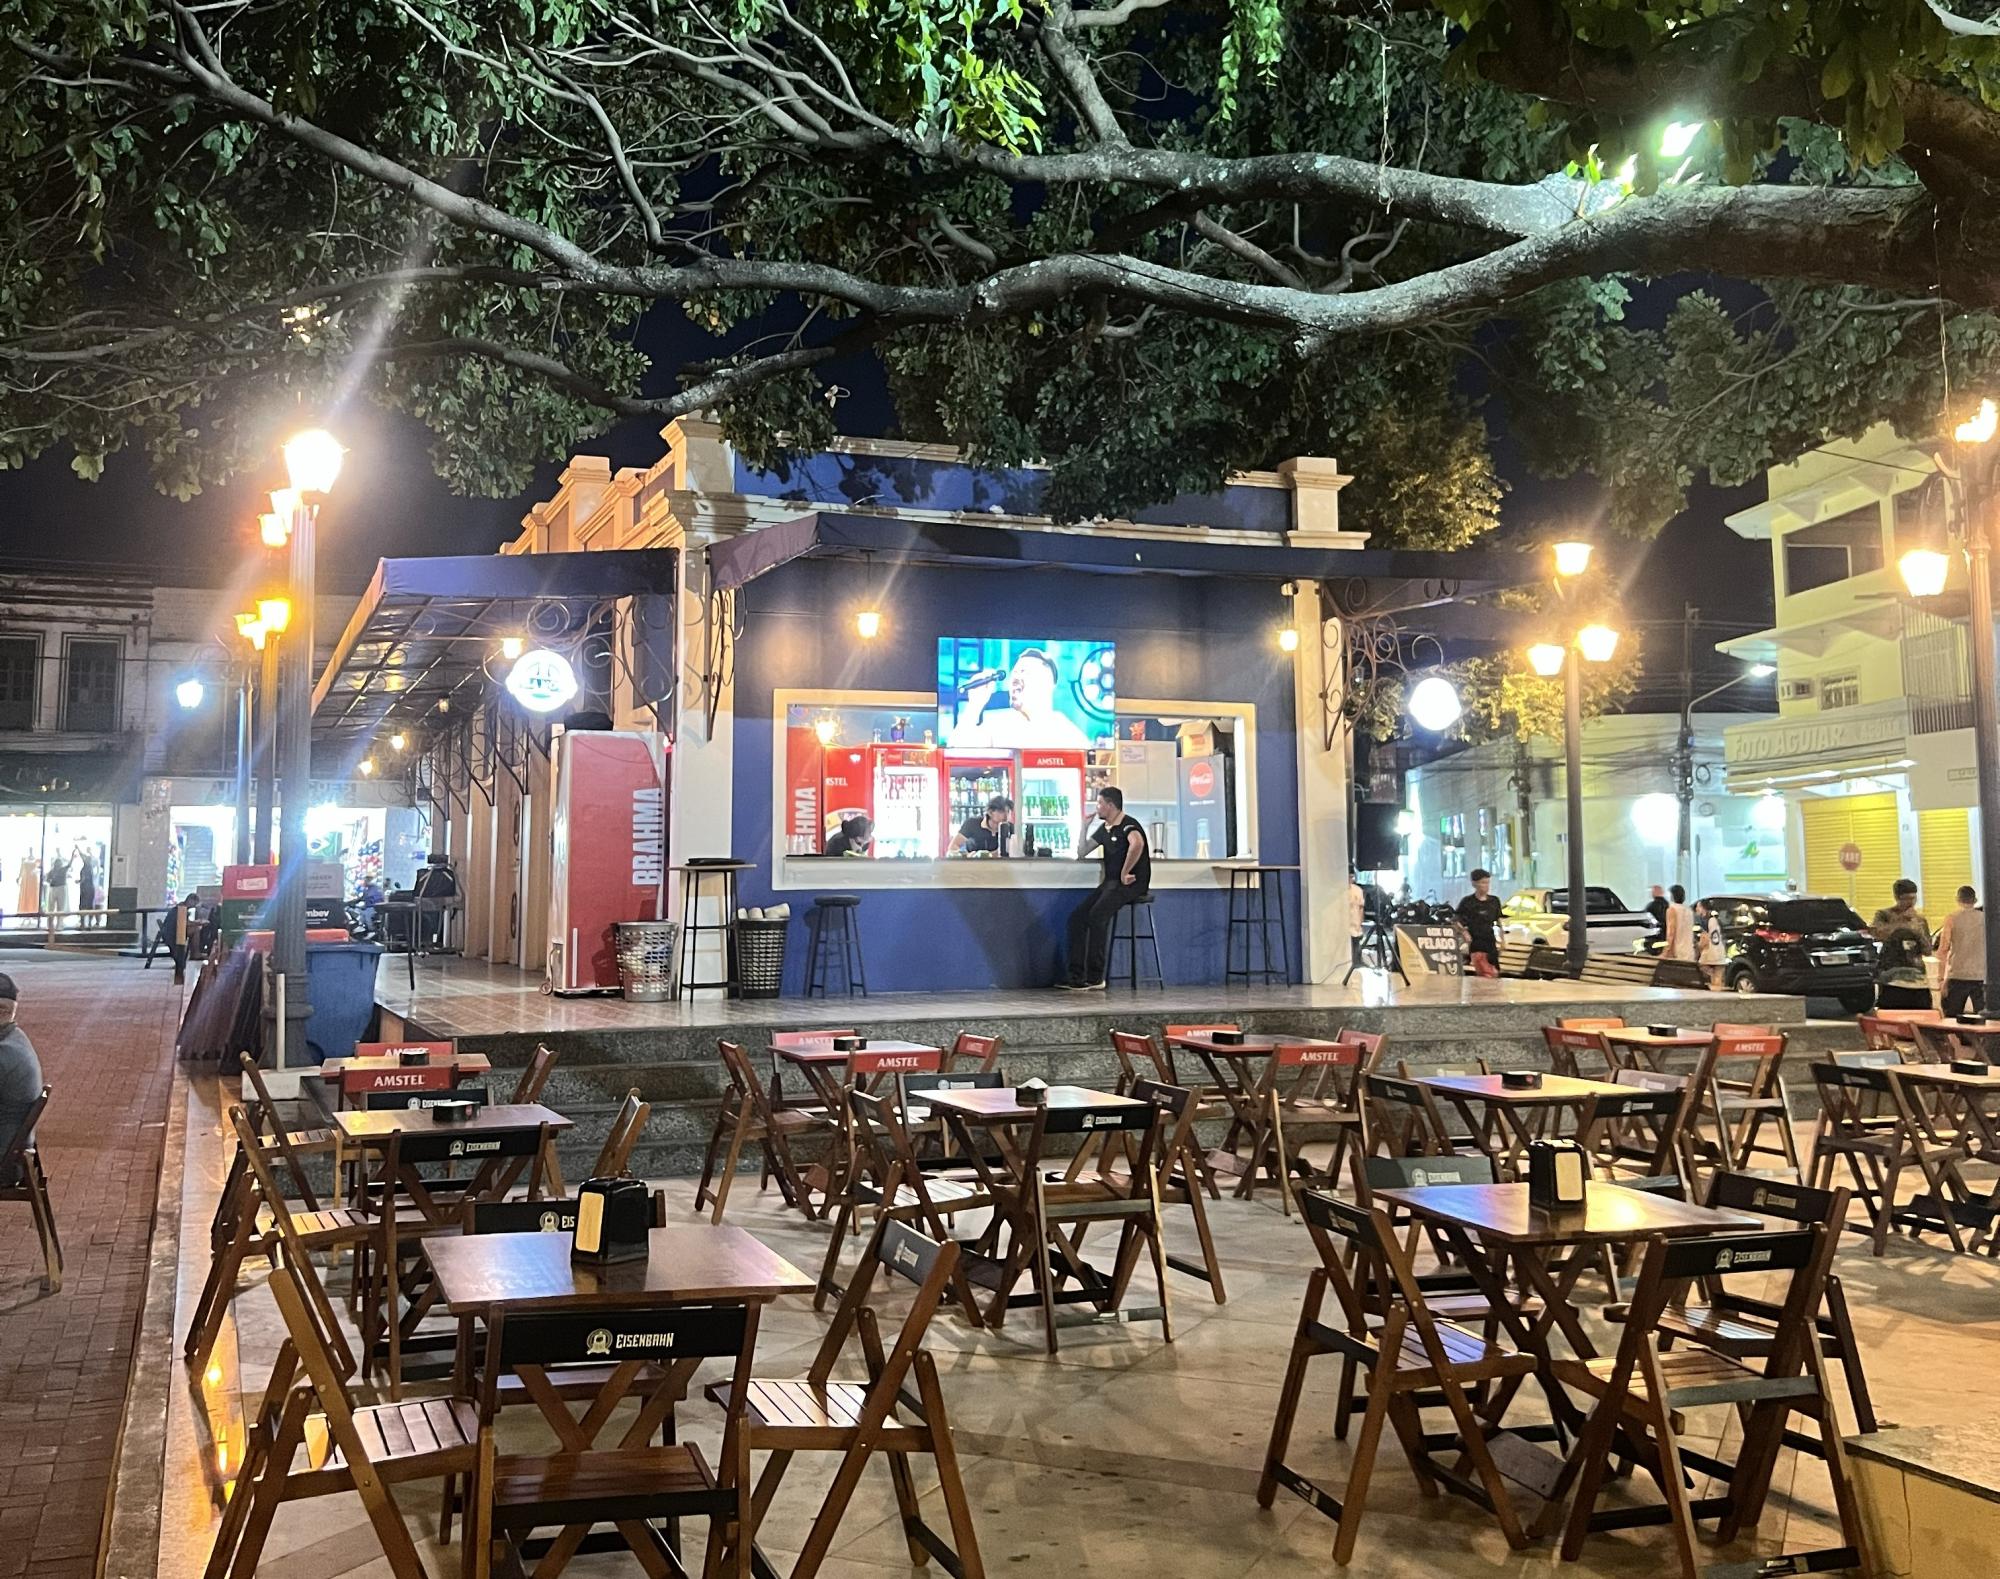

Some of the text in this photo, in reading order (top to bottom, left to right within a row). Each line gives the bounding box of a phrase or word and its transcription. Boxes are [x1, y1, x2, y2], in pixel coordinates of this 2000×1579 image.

[1736, 727, 1843, 761] FOTO AGUIAR
[1037, 757, 1065, 767] AMSTEL
[632, 787, 662, 885] BRAHMA
[1417, 937, 1456, 950] PELADO
[877, 1056, 919, 1068] AMSTEL
[1300, 1051, 1339, 1062] AMSTEL
[374, 1075, 425, 1087] AMSTEL
[616, 1333, 675, 1349] EISENBAHN
